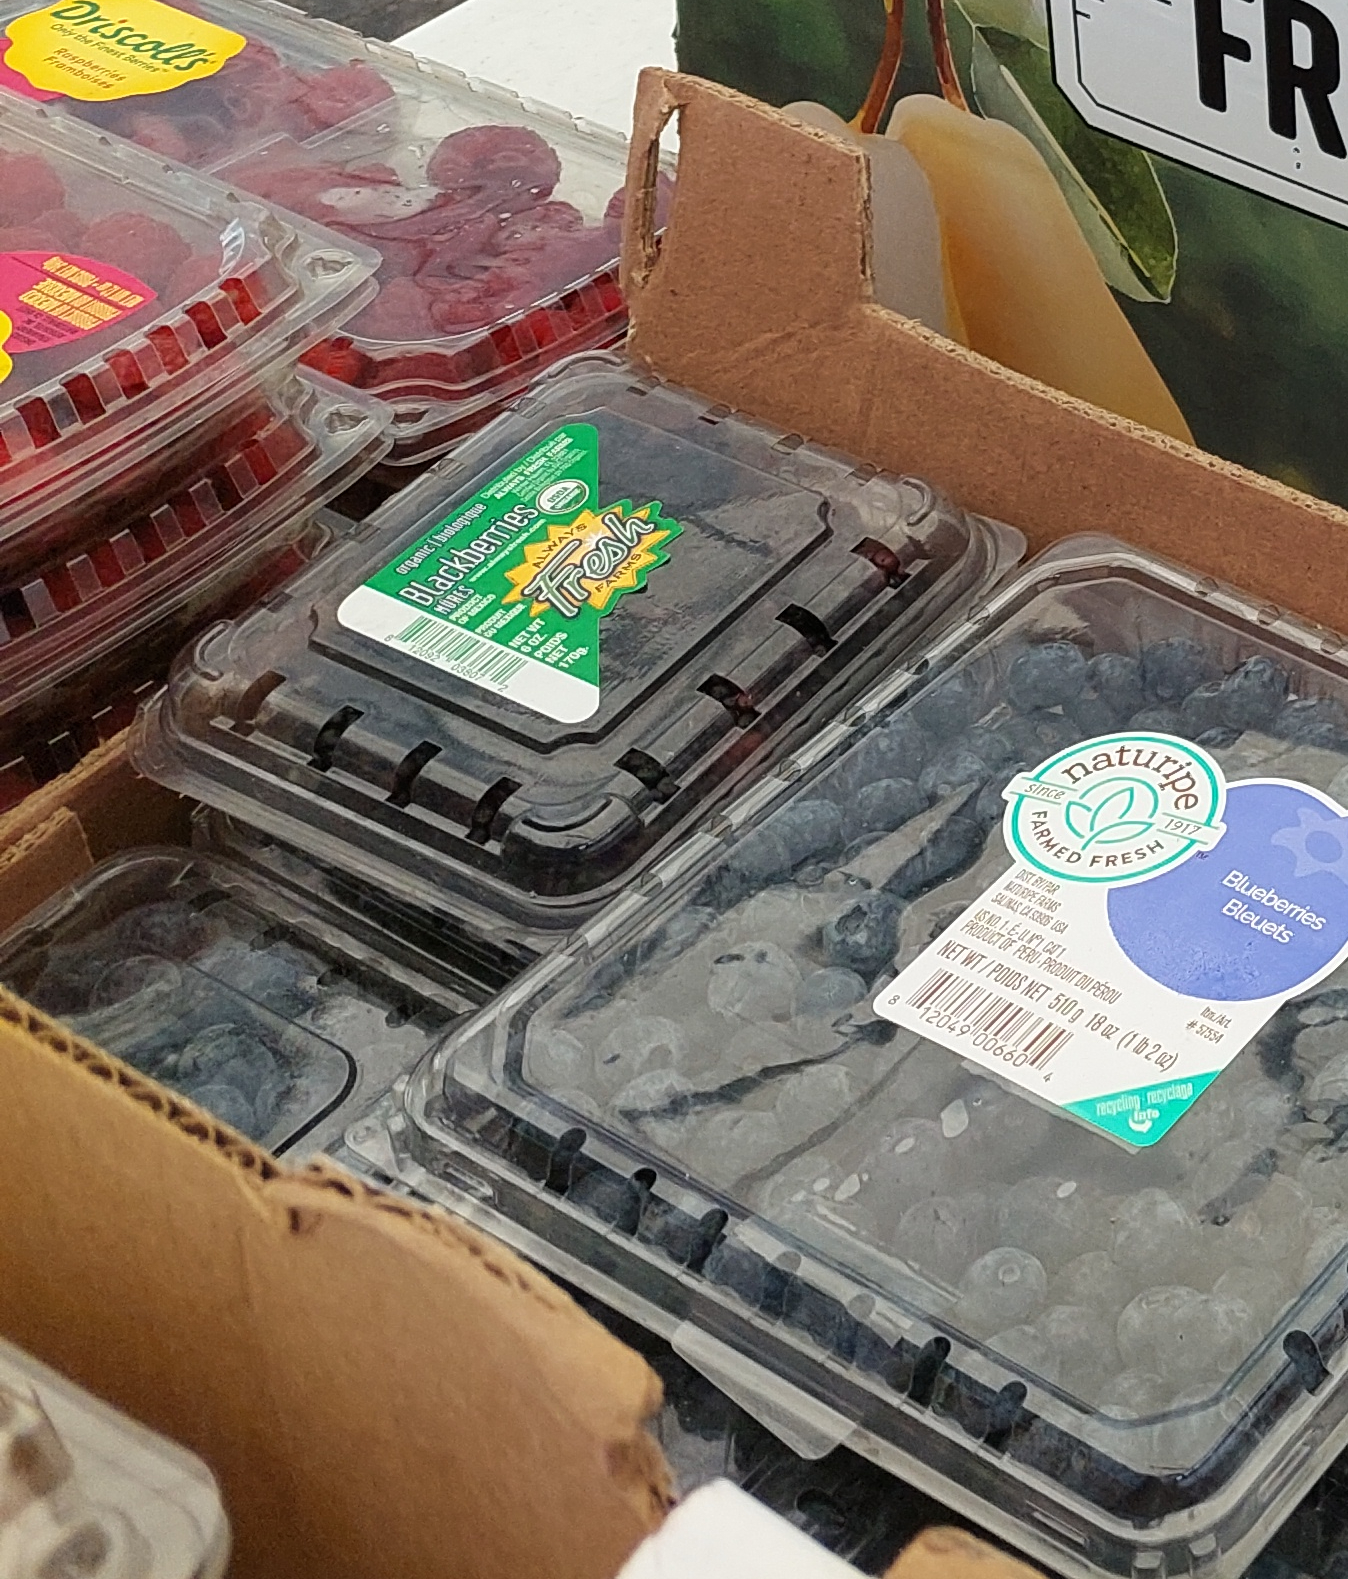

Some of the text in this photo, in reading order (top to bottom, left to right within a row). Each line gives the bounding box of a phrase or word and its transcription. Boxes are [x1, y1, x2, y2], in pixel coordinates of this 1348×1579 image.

[50, 23, 75, 39] Only
[76, 33, 92, 47] the
[50, 0, 217, 72] Driscoll's
[43, 54, 115, 90] Framboises
[53, 47, 128, 82] Raspberries
[395, 544, 437, 575] organic
[437, 502, 488, 543] biologique
[397, 503, 540, 607] Blackberries
[531, 522, 588, 570] ALWAYS
[521, 511, 658, 619] Fresh
[593, 552, 643, 594] FARMS
[507, 618, 546, 649] NET WT
[533, 631, 569, 659] POIDS
[407, 643, 442, 664] 12092
[543, 644, 569, 665] NET
[1023, 782, 1066, 801] since
[1060, 744, 1200, 811] naturipe
[1030, 810, 1165, 869] FARMED FRESH
[1162, 818, 1204, 837] 1917
[974, 907, 990, 923] US
[1220, 869, 1328, 932] Blueberries
[1050, 919, 1070, 935] USA
[1220, 897, 1297, 945] Bleuets
[959, 919, 1124, 1005] PRODUCT OF PERU PRODUIT DU PÉROU
[936, 939, 968, 962] NET
[961, 950, 990, 971] WT
[985, 962, 1029, 991] POIDS
[1021, 980, 1054, 1003] NET
[1046, 992, 1078, 1017] 510
[1084, 1011, 1108, 1033] 18
[1101, 1021, 1122, 1040] oz
[1153, 1050, 1180, 1073] oz)
[886, 994, 1054, 1084] 8 12049 00660 4
[1095, 1082, 1194, 1118] recycling recyclage
[1133, 1107, 1161, 1122] info
